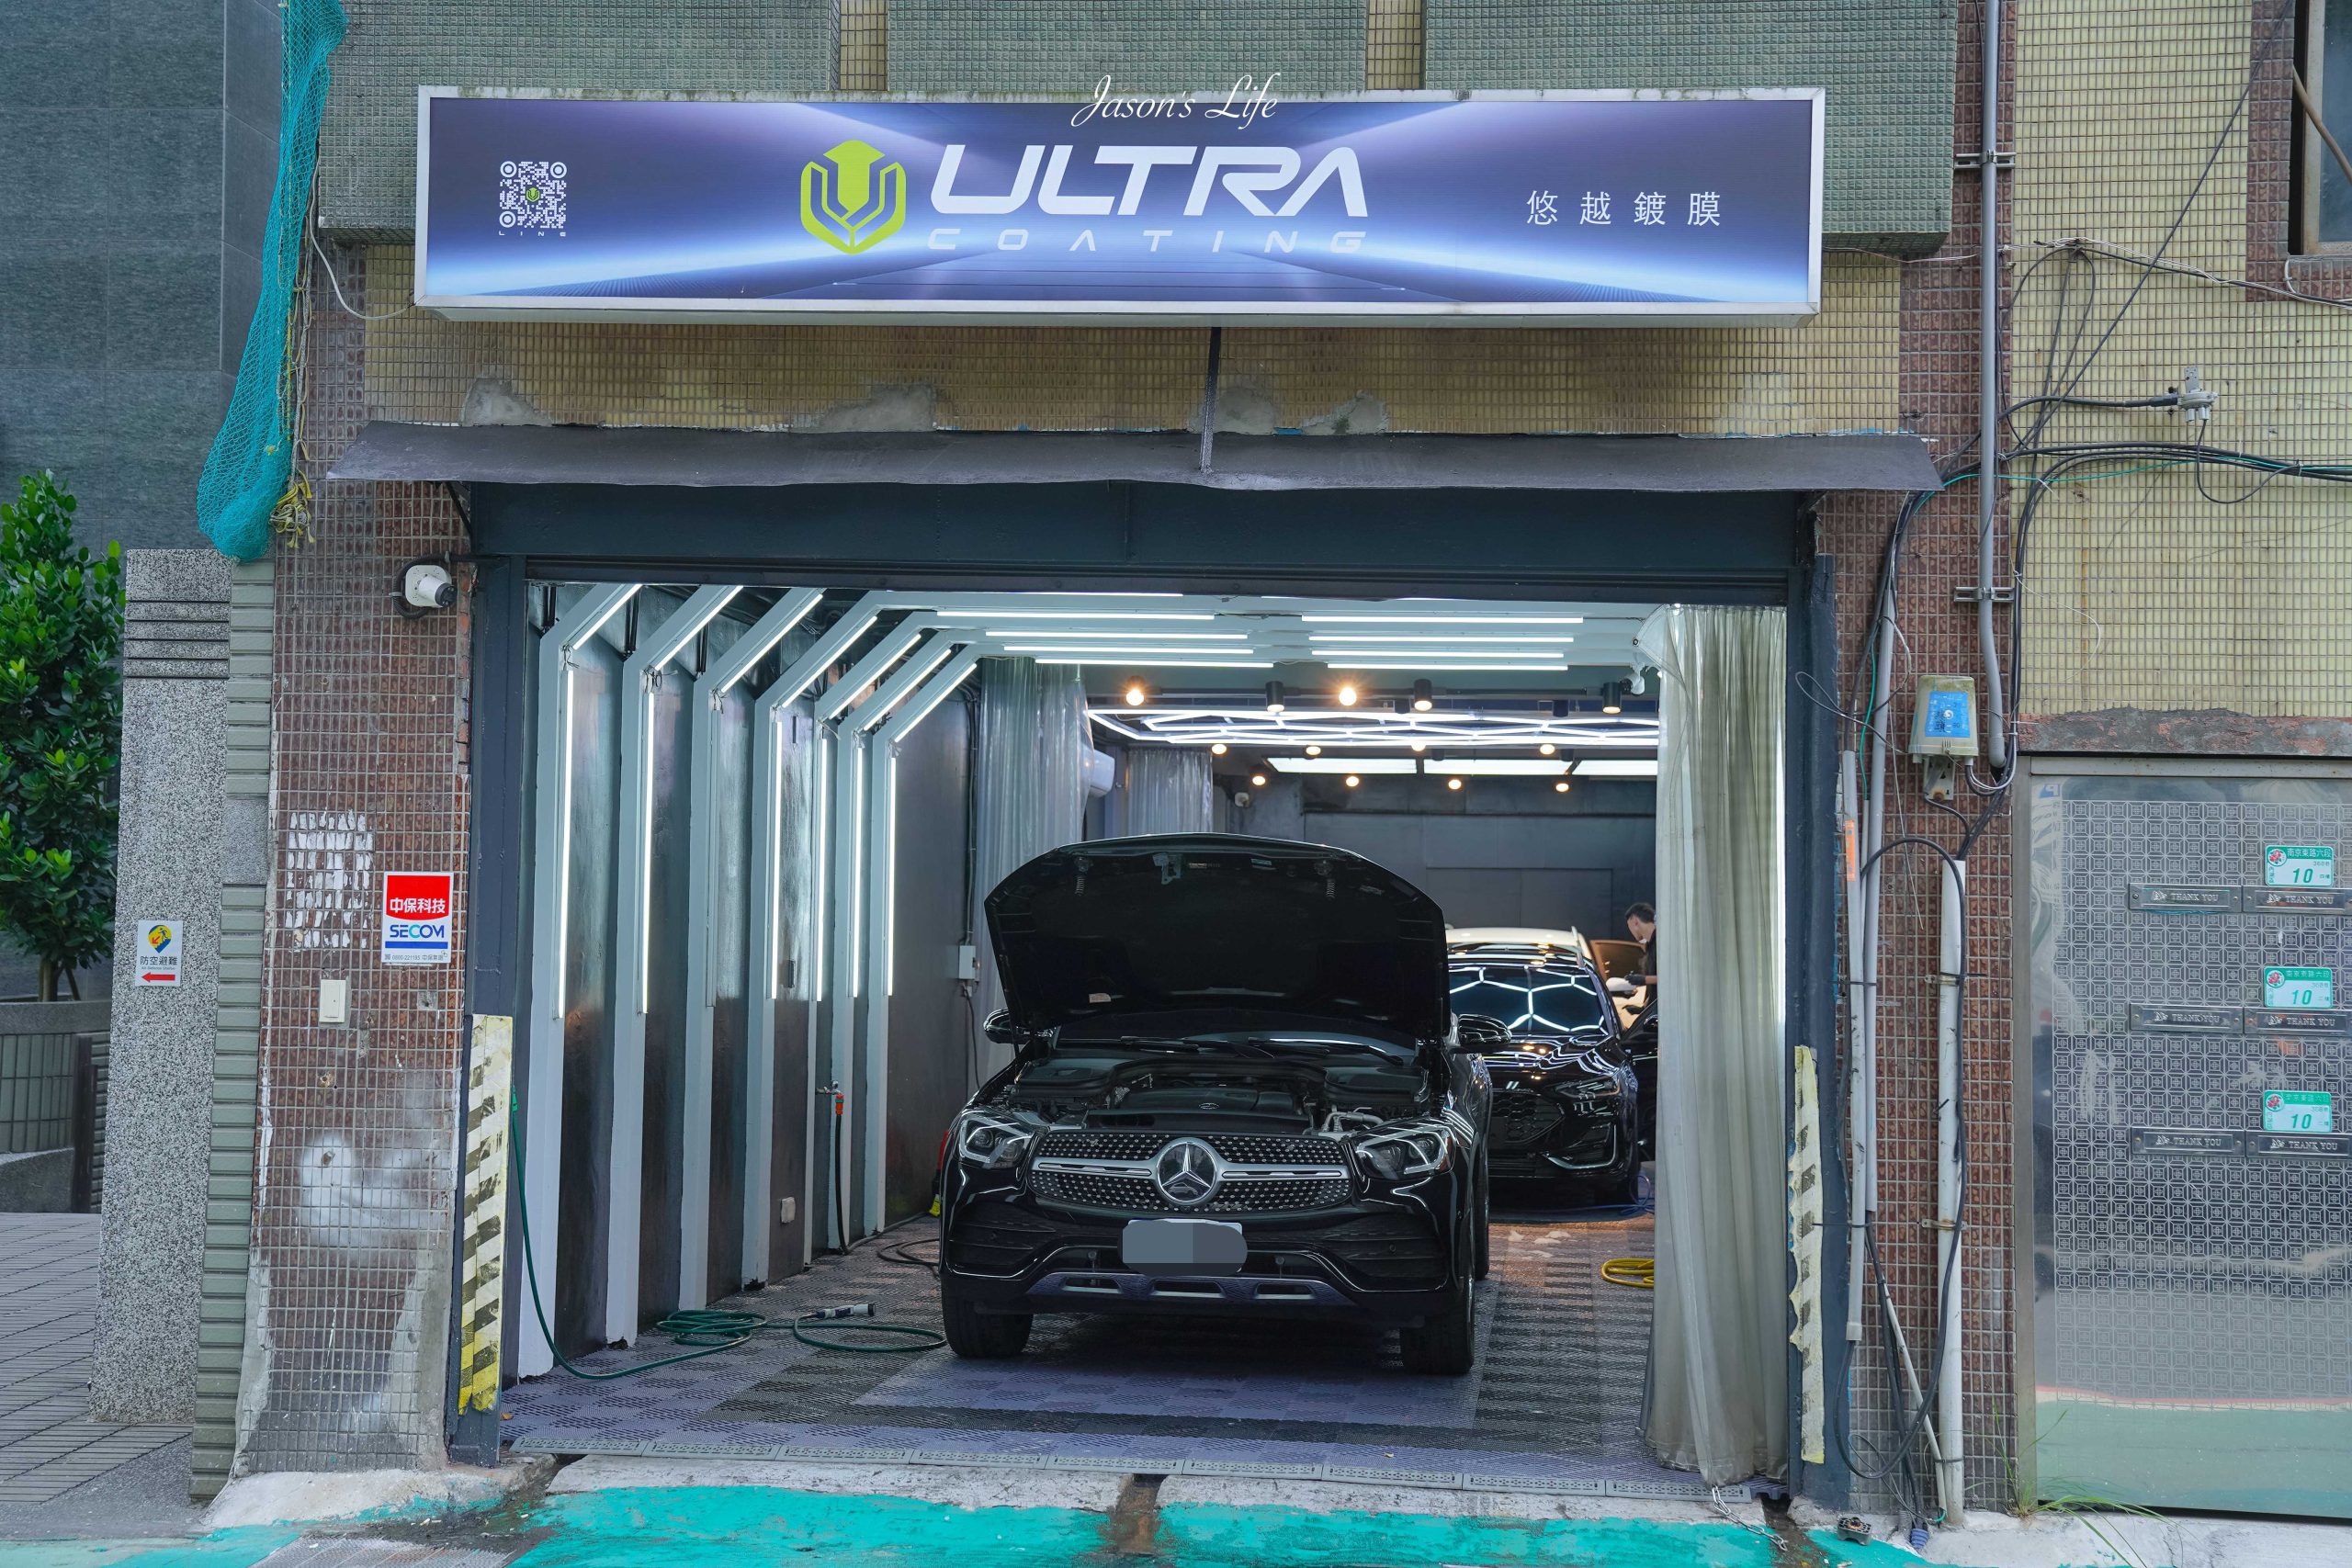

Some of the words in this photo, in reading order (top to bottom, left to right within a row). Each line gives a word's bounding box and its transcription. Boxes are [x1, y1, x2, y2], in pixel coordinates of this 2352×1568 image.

[931, 144, 1368, 218] ULTRA
[1526, 189, 1721, 227] 悠越鍍膜
[927, 228, 1367, 254] COATING
[2292, 868, 2313, 884] 10
[2170, 893, 2199, 901] THANK
[2201, 894, 2219, 902] YOU
[2285, 895, 2314, 903] THANK
[2316, 896, 2335, 905] YOU
[390, 897, 446, 914] 中保科技
[390, 924, 445, 939] SECOM
[140, 955, 177, 965] 防空避難
[2292, 989, 2312, 1005] 10
[2171, 1013, 2203, 1021] THANK
[2286, 1017, 2315, 1025] THANK
[2317, 1018, 2335, 1026] YOU
[2291, 1113, 2312, 1129] 10
[2173, 1136, 2202, 1145] THANK
[2204, 1138, 2222, 1146] YOU
[2288, 1140, 2318, 1150] THANK
[2320, 1142, 2338, 1150] YOU
